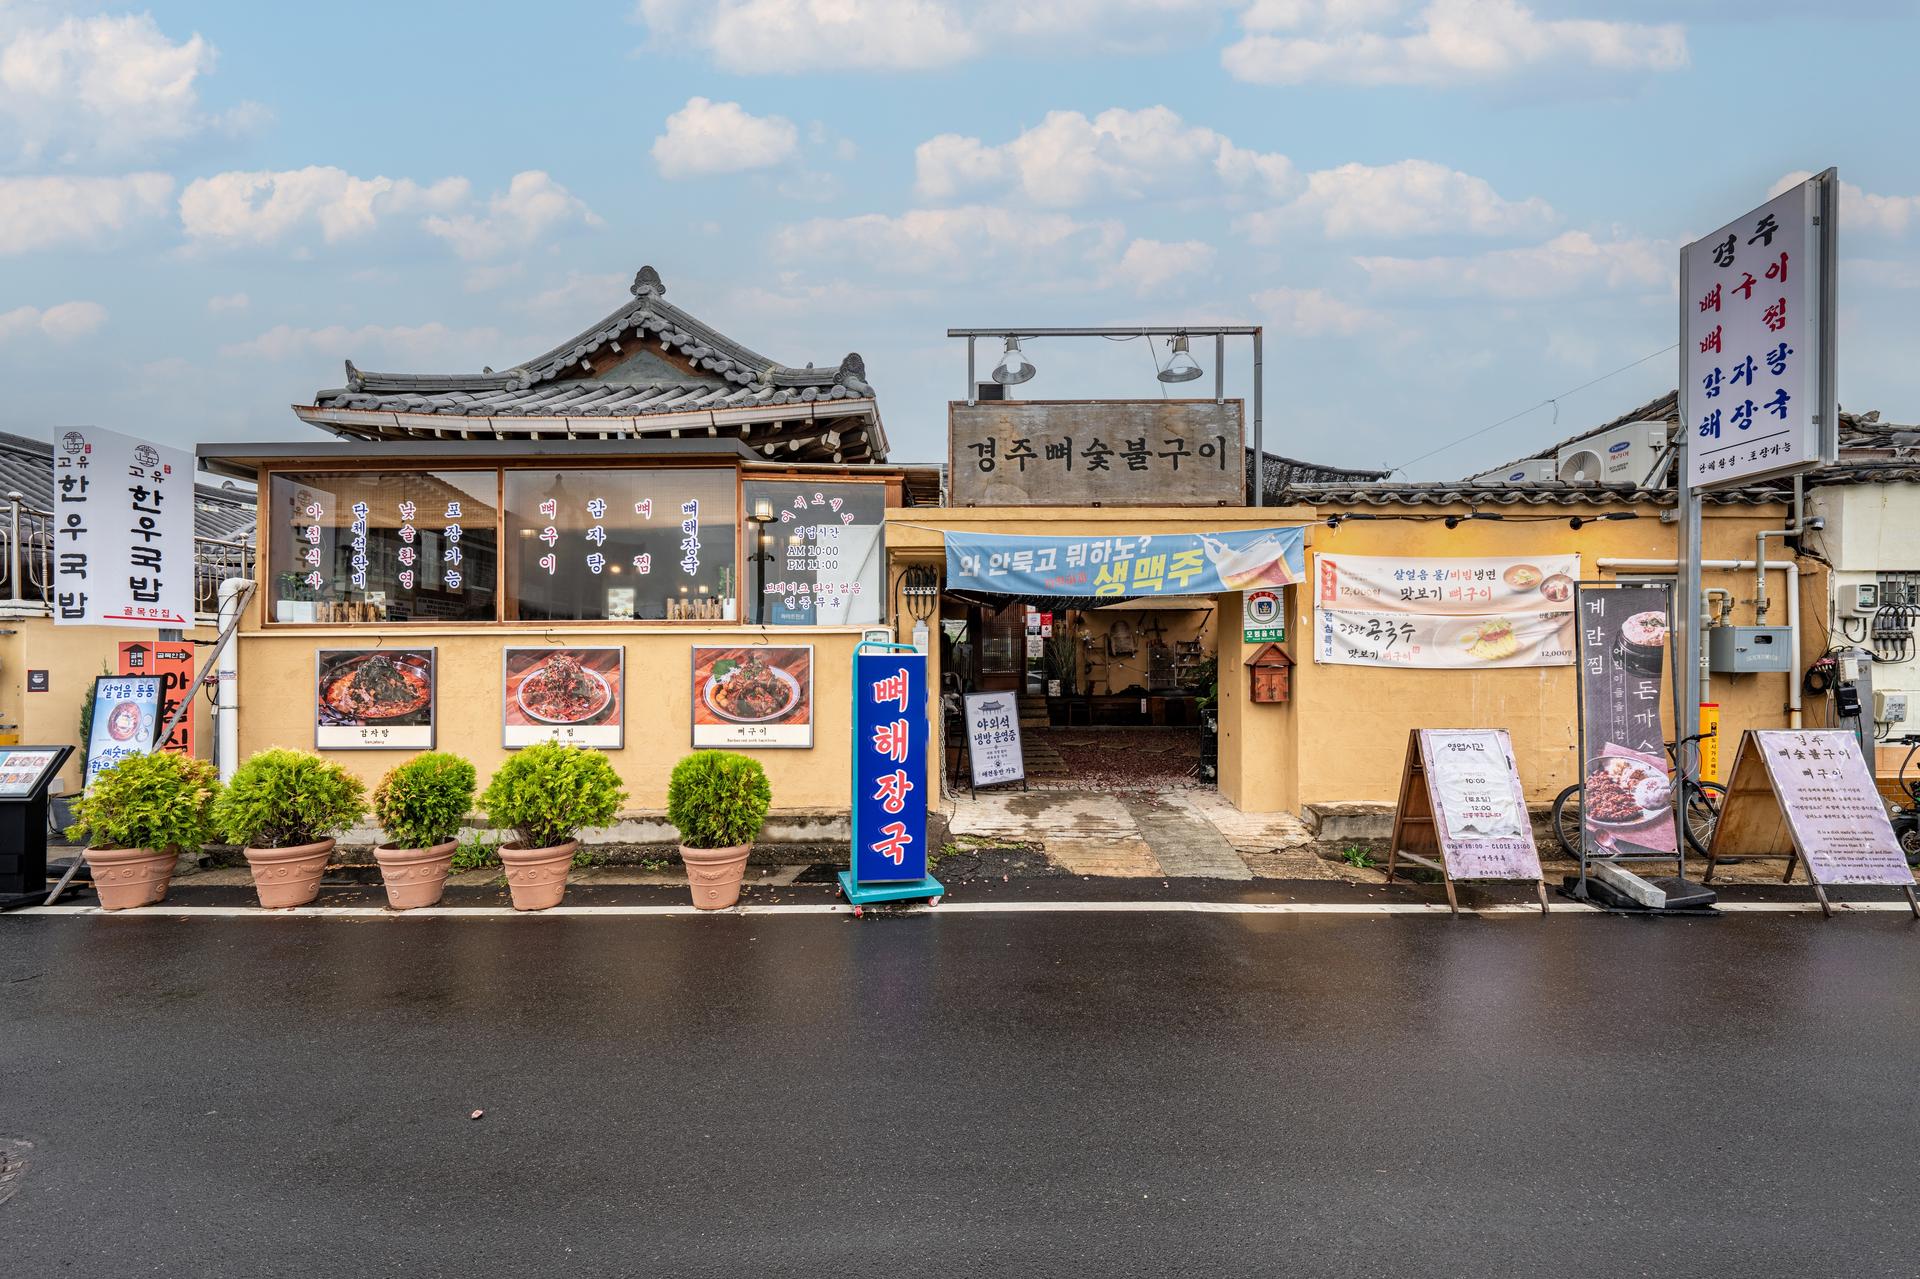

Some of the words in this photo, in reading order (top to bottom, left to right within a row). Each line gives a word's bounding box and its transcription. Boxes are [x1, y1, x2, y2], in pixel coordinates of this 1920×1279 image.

[1712, 213, 1779, 268] 경주
[1699, 252, 1788, 313] 뼈구이
[1699, 298, 1787, 353] 뼈찜
[1703, 342, 1794, 399] 감자탕
[1699, 388, 1791, 439] 해장국
[57, 455, 90, 468] 고유
[967, 436, 1227, 473] 경주뼈숯불구이
[1748, 442, 1791, 463] 포장가능
[128, 464, 164, 484] 고유
[57, 474, 90, 619] 한우국밥
[127, 485, 164, 603] 한우국밥
[304, 502, 323, 590] 아침식사
[351, 501, 368, 590] 단체석완비
[398, 500, 416, 590] 낮술환영
[444, 501, 462, 589] 포장가능
[540, 498, 559, 575] 뼈구이
[586, 498, 607, 575] 감자탕
[633, 499, 651, 575] 뼈찜
[680, 498, 701, 577] 뼈해장국
[794, 526, 839, 539] 영업시간
[786, 545, 805, 556] AM
[808, 545, 839, 556] 10:00
[786, 560, 805, 570] PM
[808, 560, 839, 570] 11:00
[958, 556, 981, 577] 와
[988, 549, 1057, 576] 안묵고
[1066, 536, 1153, 567] 뭐하노?
[764, 582, 810, 595] 브레이크
[813, 582, 834, 594] 타임
[839, 583, 862, 594] 없음
[1094, 548, 1204, 597] 생맥주
[1394, 568, 1429, 581] 살얼음
[785, 596, 841, 609] 연중무휴
[1400, 586, 1443, 601] 맛보기
[1449, 586, 1492, 602] 뼈구이
[123, 606, 170, 618] 골목안집
[1366, 618, 1417, 650] 콩국수
[1585, 598, 1606, 675] 계란찜
[1348, 648, 1379, 660] 맛보기
[103, 684, 132, 699] 살얼음
[136, 684, 155, 698] 동동
[360, 729, 389, 738] 감자탕
[738, 727, 767, 736] 뼈구이
[977, 715, 1010, 731] 야외석
[1633, 680, 1659, 755] 돈까스
[974, 732, 993, 746] 냉방
[993, 729, 1017, 743] 운영중
[1447, 743, 1485, 752] 영업시간
[1778, 748, 1851, 760] 뼈숯불구이
[872, 668, 914, 865] 뼈해장국
[1802, 768, 1843, 779] 뼈구이
